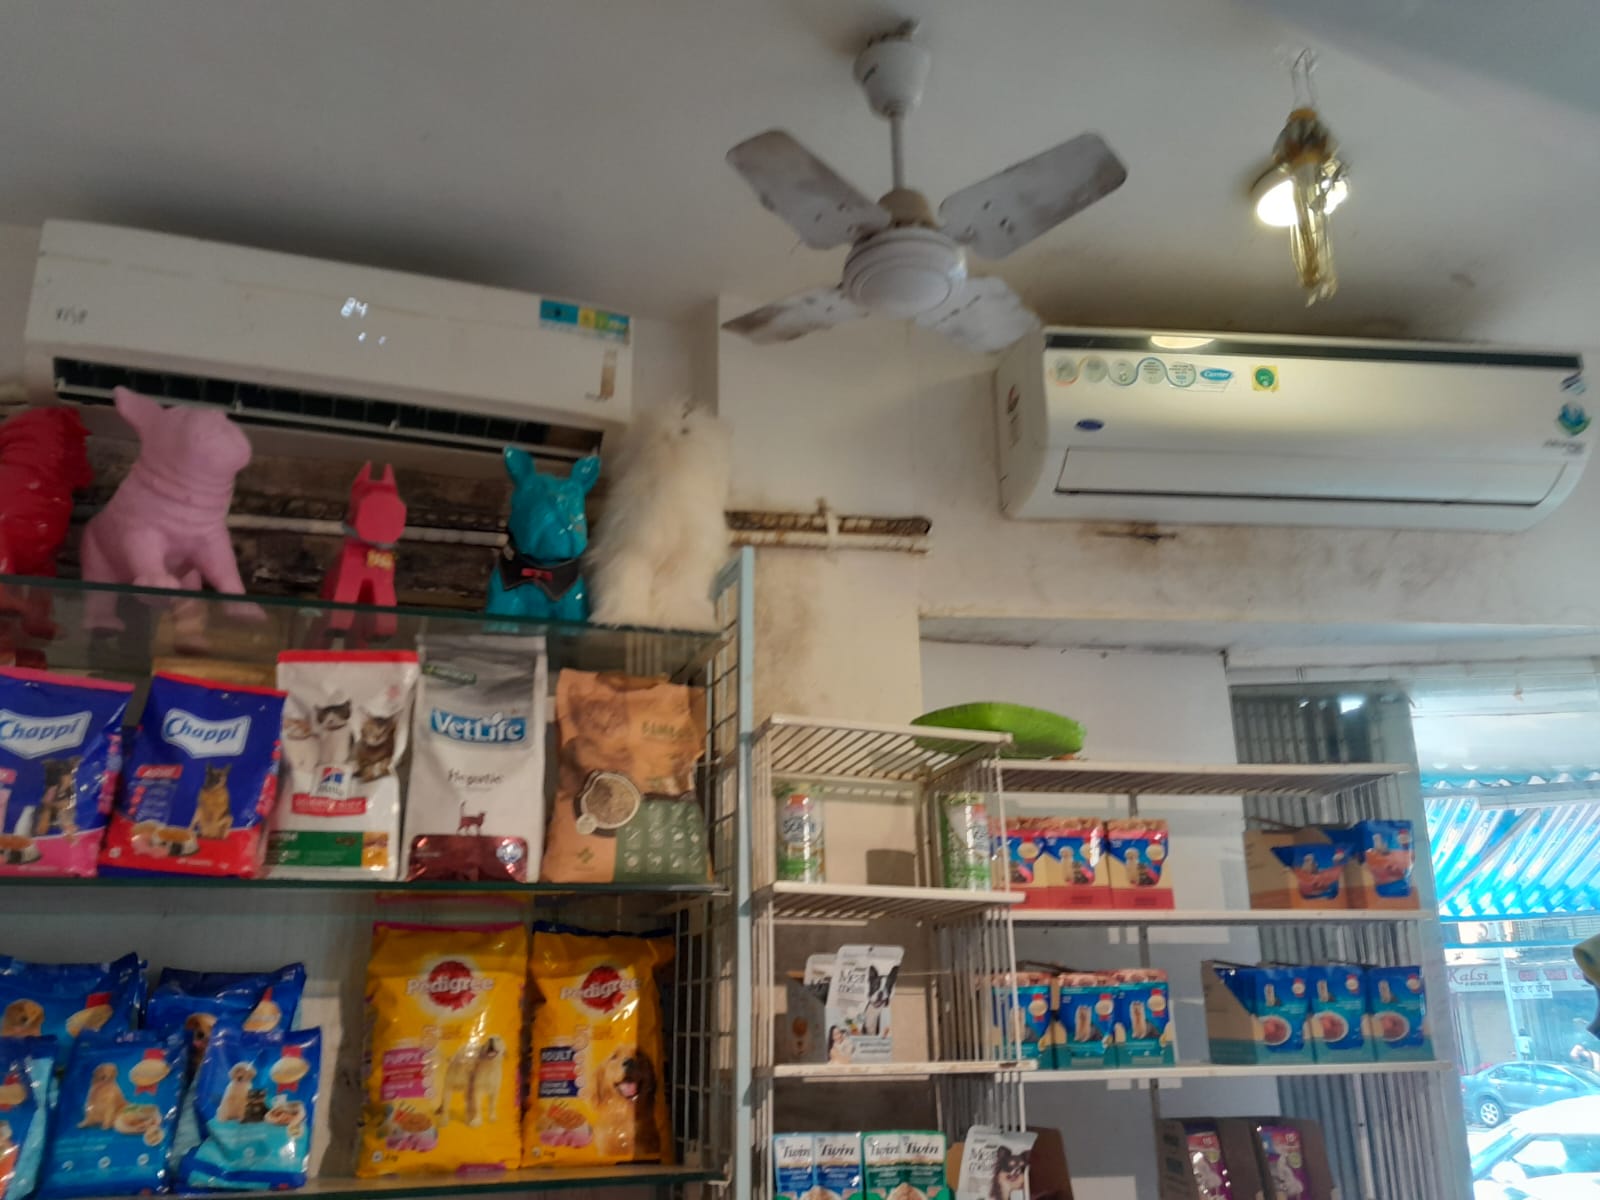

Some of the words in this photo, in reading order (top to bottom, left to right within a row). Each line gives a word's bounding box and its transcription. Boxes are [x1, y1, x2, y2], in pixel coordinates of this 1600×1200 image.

[0, 717, 79, 740] Chappi
[164, 715, 240, 742] Chappi
[433, 710, 521, 741] VetLife
[407, 973, 494, 995] Pedigree
[561, 975, 639, 1000] Pedigree
[782, 1144, 811, 1159] Twin
[820, 1143, 856, 1157] Twin
[904, 1142, 939, 1155] Twin
